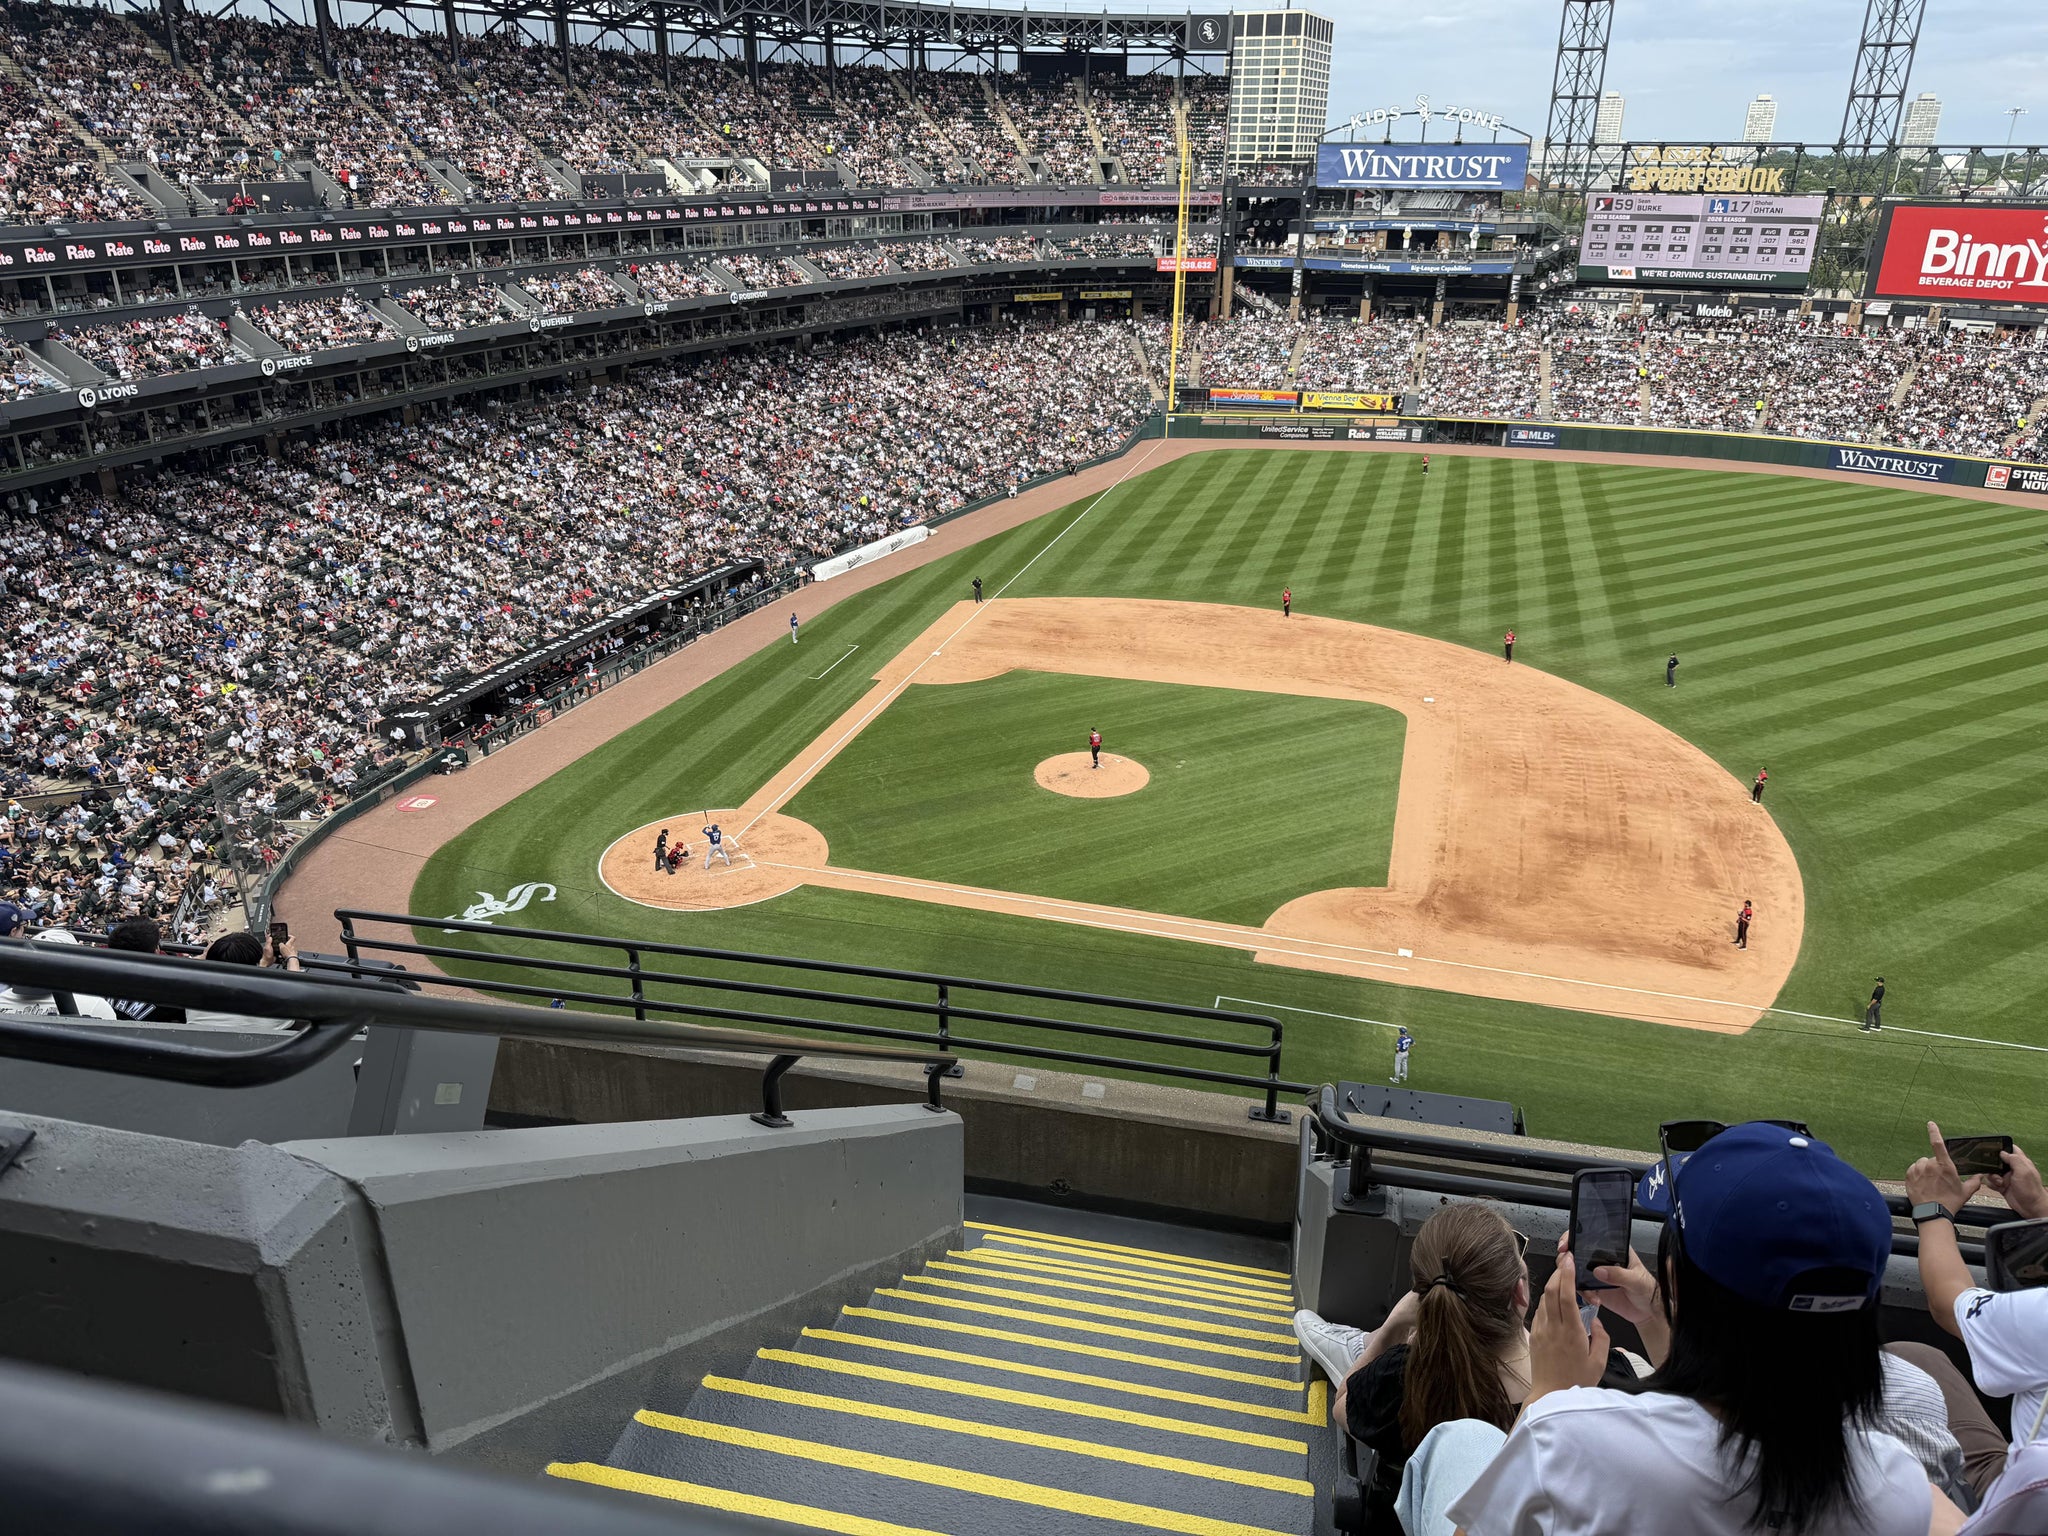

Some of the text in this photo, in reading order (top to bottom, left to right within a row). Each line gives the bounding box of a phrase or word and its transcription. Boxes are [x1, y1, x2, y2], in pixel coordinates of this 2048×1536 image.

[1350, 106, 1401, 129] KIDS
[1443, 105, 1504, 131] ZONE
[1634, 146, 1724, 162] CAESARS
[1629, 167, 1785, 193] SPORTSBOOK
[1614, 199, 1634, 210] 59
[1730, 201, 1751, 213] 17
[24, 248, 56, 263] Rate
[66, 245, 96, 260] Rate
[105, 242, 134, 257] Rate
[143, 240, 171, 254] Rate
[180, 237, 206, 251] Rate
[214, 235, 240, 249] Rate
[248, 233, 271, 246] Rate
[279, 231, 302, 244] Rate
[310, 229, 333, 242] Rate
[340, 227, 362, 240] Rate
[368, 226, 389, 238] Rate
[396, 224, 415, 236] Rate
[422, 223, 441, 234] Rate
[448, 221, 467, 233] Rate
[473, 220, 491, 231] Rate
[497, 218, 514, 230] Rate
[520, 217, 537, 228] Rate
[542, 216, 559, 227] Rate
[565, 215, 581, 225] Rate
[586, 213, 602, 224] Rate
[607, 212, 622, 223] Rate
[627, 211, 642, 221] Rate
[647, 210, 661, 220] Rate
[666, 209, 680, 219] Rate
[685, 208, 699, 218] Rate
[703, 207, 717, 217] Rate
[721, 206, 734, 216] Rate
[739, 206, 752, 216] Rate
[756, 205, 769, 215] Rate
[773, 204, 785, 214] Rate
[790, 203, 802, 213] Rate
[806, 203, 818, 212] Rate
[821, 202, 833, 211] Rate
[837, 201, 849, 210] Rate
[852, 200, 864, 209] Rate
[867, 200, 879, 209] Rate
[1246, 258, 1283, 266] WINTRUST
[1341, 262, 1369, 270] Hometown
[1612, 269, 1633, 277] WM
[1641, 269, 1668, 278] WE'RE
[1669, 270, 1704, 279] DRIVING
[1918, 276, 2014, 289] BEVERAGE DEPOT
[739, 290, 768, 300] ROBINSON
[654, 303, 668, 312] FISK
[1696, 304, 1732, 317] Modelo
[531, 316, 574, 329] 56 BUEHRLE
[408, 334, 454, 348] 35 THOMAS
[264, 355, 313, 372] 19 PIERCE
[82, 385, 138, 403] 16 LYONS
[1318, 393, 1360, 402] Vienna Beef
[1280, 432, 1309, 440] Companies
[1348, 428, 1370, 439] Rate
[1529, 431, 1556, 440] MLB+
[1840, 449, 1943, 477] WINTRUST
[496, 650, 547, 674] CHICAGO
[457, 674, 499, 693] WHITE
[428, 693, 458, 706] SOX
